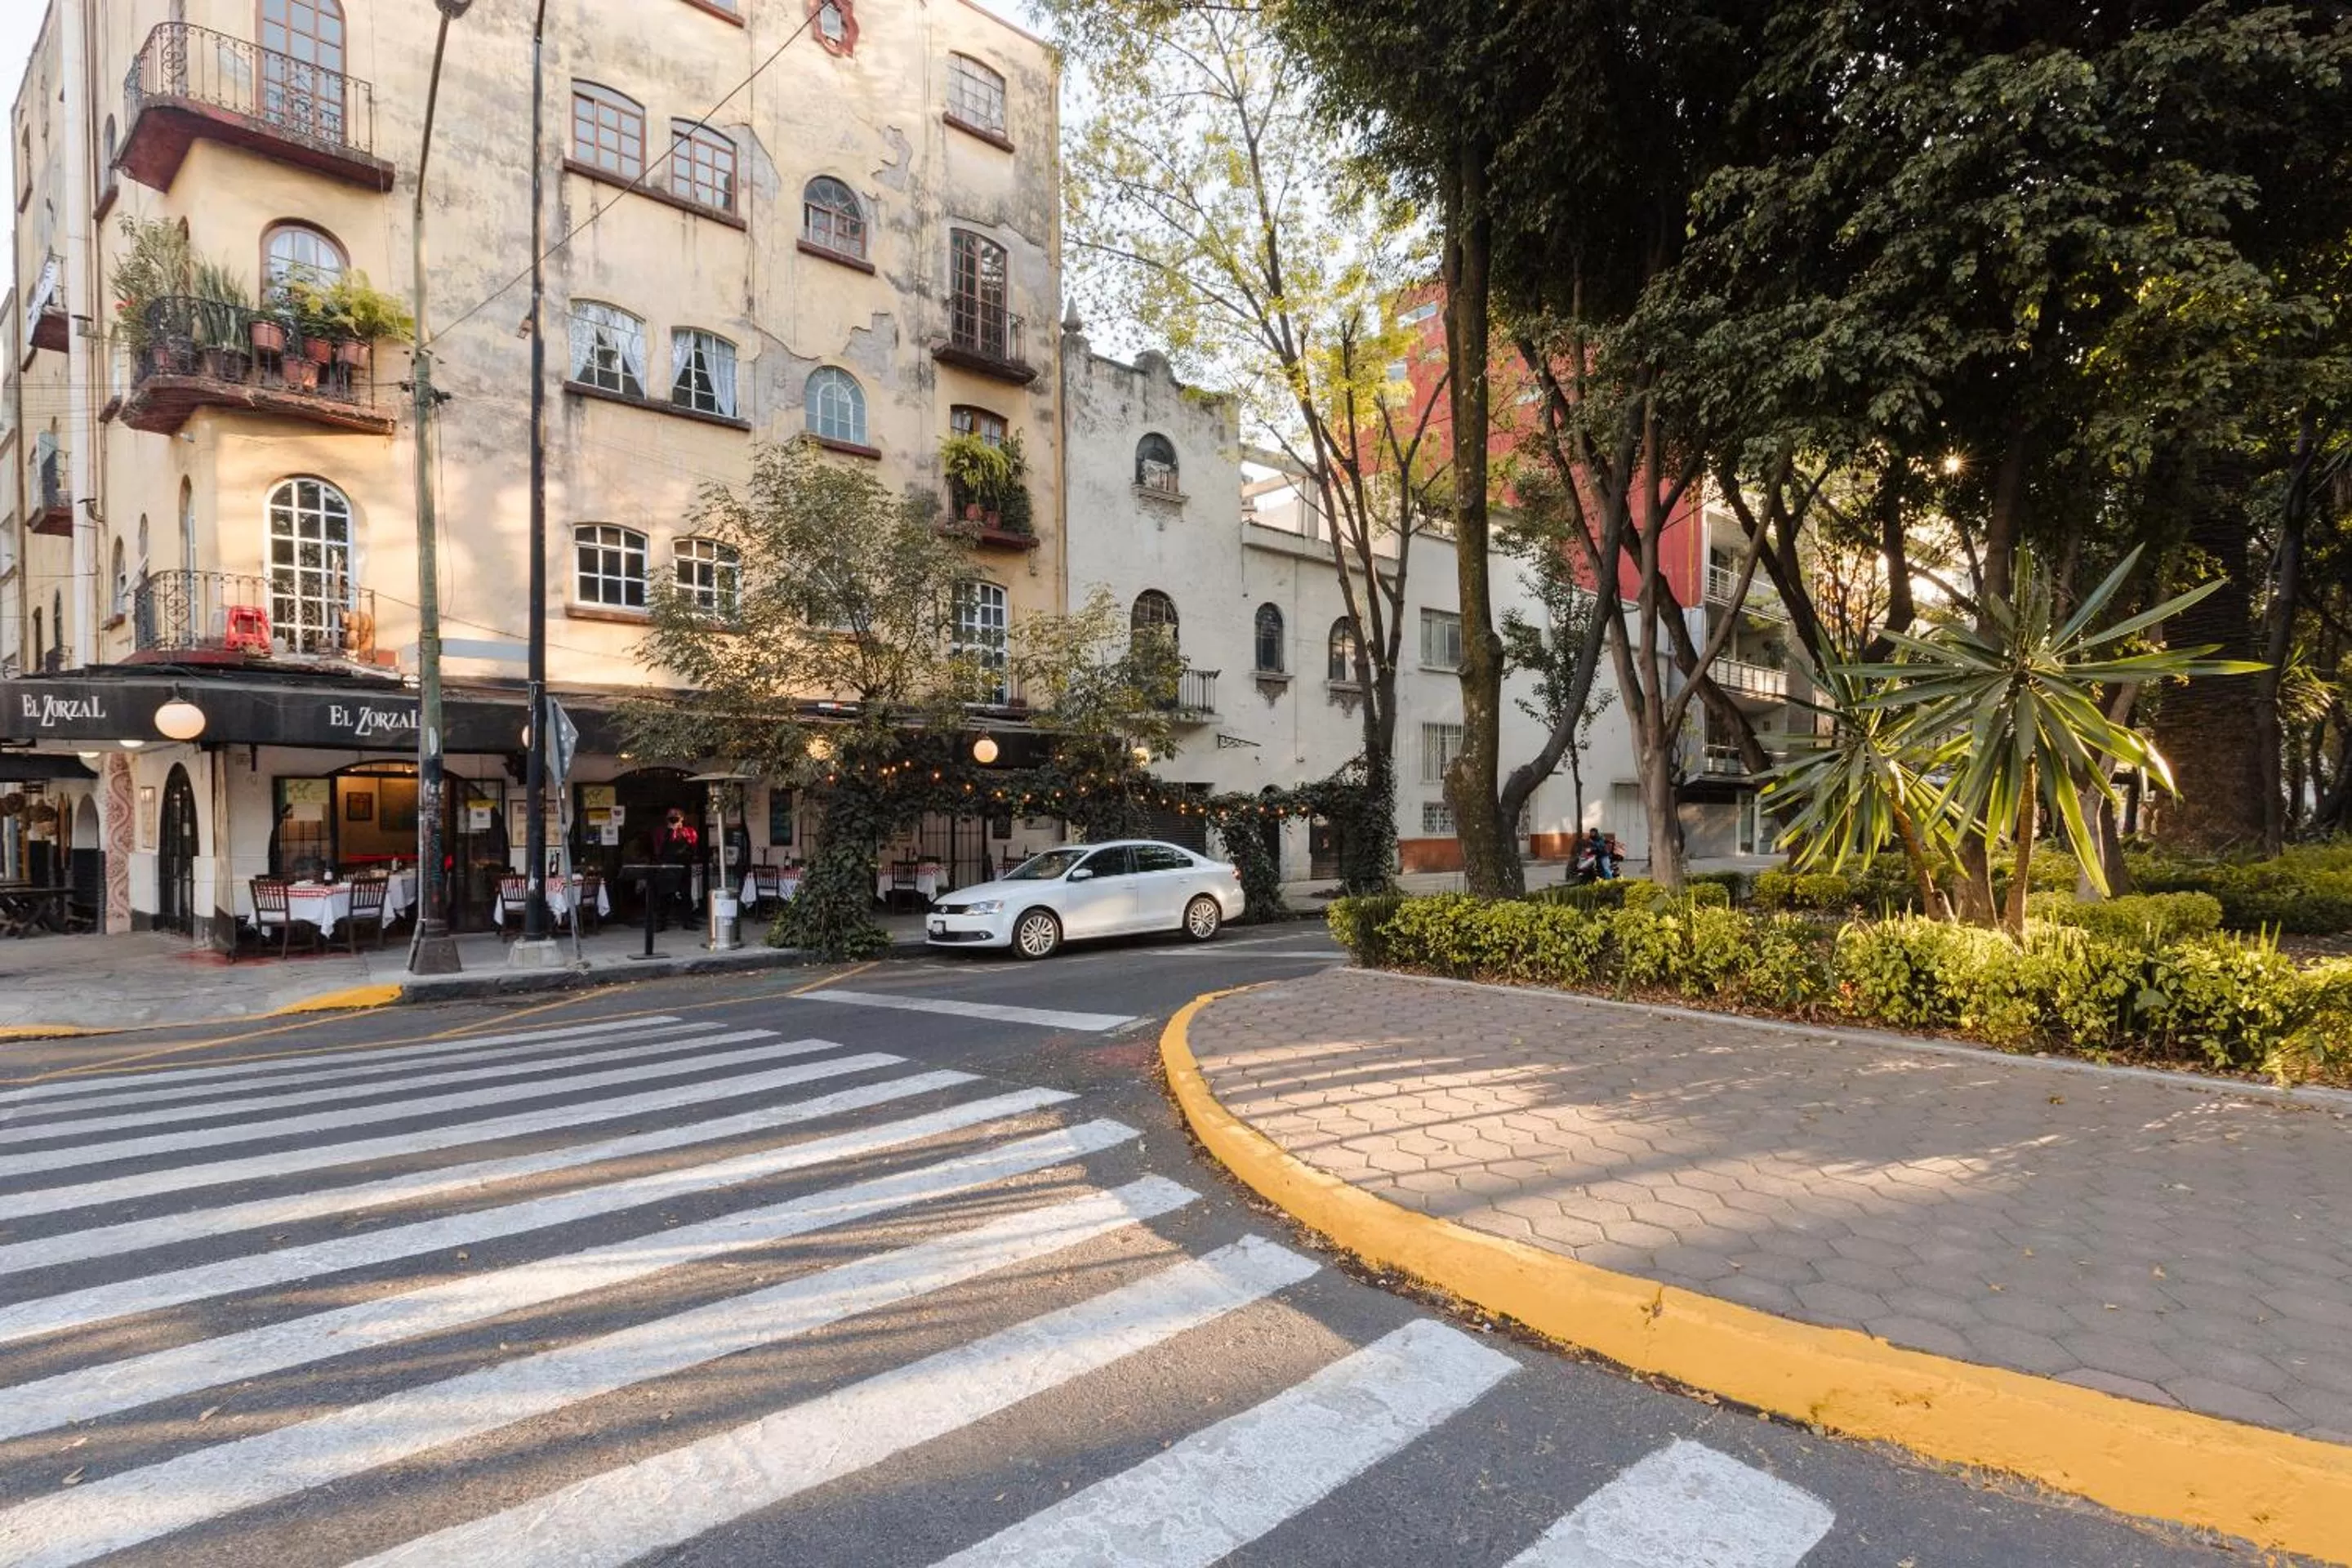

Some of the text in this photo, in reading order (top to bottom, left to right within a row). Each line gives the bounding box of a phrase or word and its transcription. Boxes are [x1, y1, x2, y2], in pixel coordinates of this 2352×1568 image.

[21, 694, 106, 726] EL ZORZAL
[329, 705, 353, 727] EL
